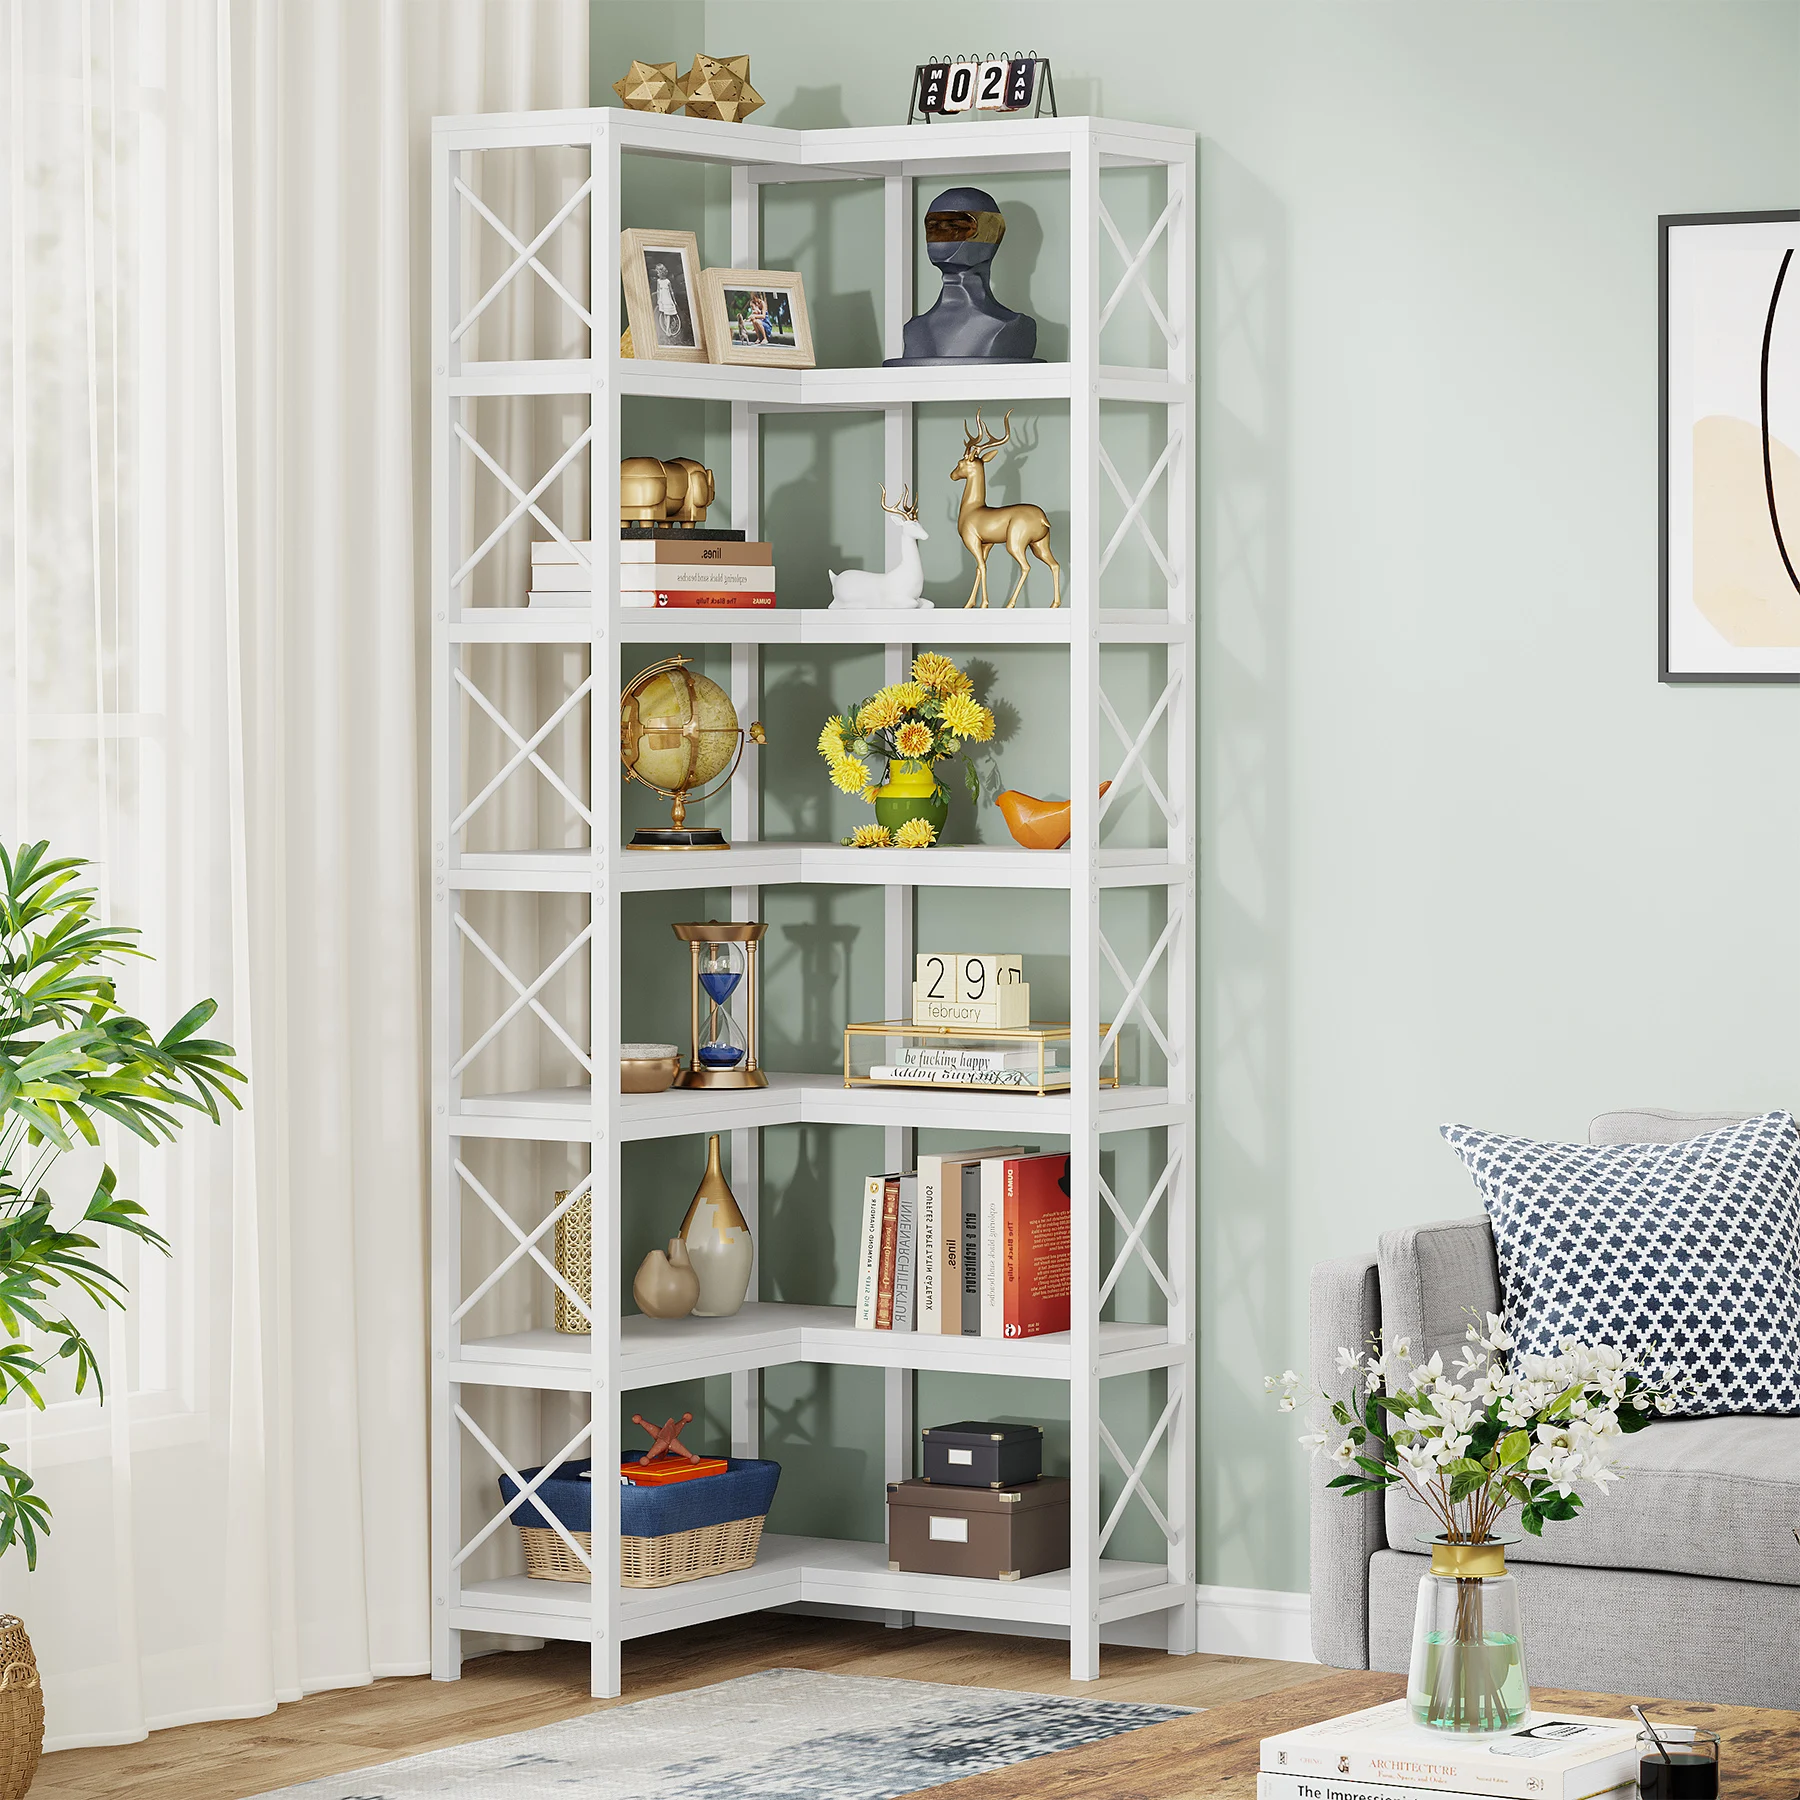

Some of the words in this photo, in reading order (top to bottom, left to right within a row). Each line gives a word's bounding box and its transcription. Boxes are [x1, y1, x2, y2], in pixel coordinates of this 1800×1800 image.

[927, 69, 943, 106] MAR
[1014, 64, 1026, 101] JAN
[926, 957, 985, 1000] 29
[928, 1002, 982, 1023] february
[904, 1050, 917, 1065] be
[919, 1050, 958, 1068] fucking
[959, 1052, 991, 1070] happy
[1369, 1759, 1458, 1777] ARCHITECTURE
[1297, 1785, 1322, 1799] The
